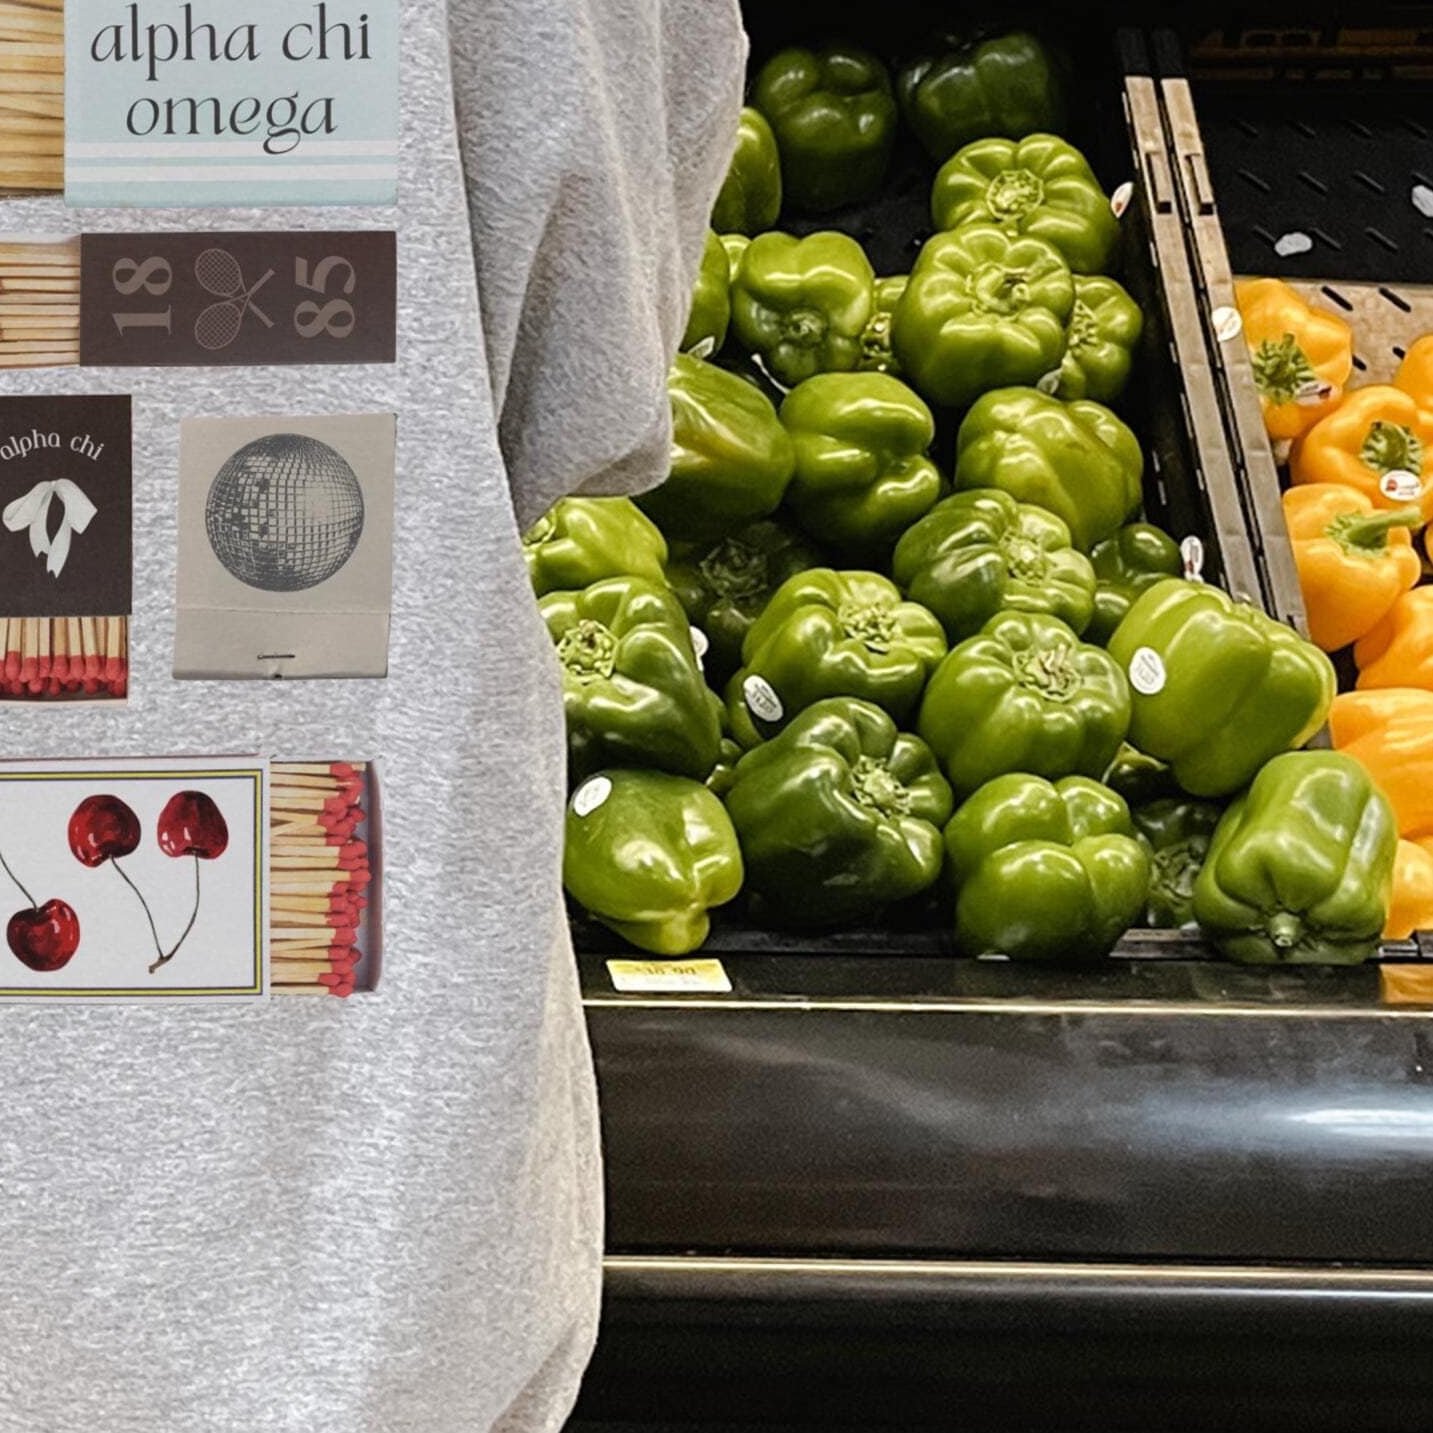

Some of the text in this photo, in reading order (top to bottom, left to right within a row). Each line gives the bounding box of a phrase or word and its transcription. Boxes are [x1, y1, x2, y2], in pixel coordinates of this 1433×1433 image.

[90, 2, 372, 81] alpha chi
[126, 90, 338, 155] omega
[112, 256, 173, 335] 18
[294, 255, 356, 338] 85
[0, 429, 105, 461] alpha chi
